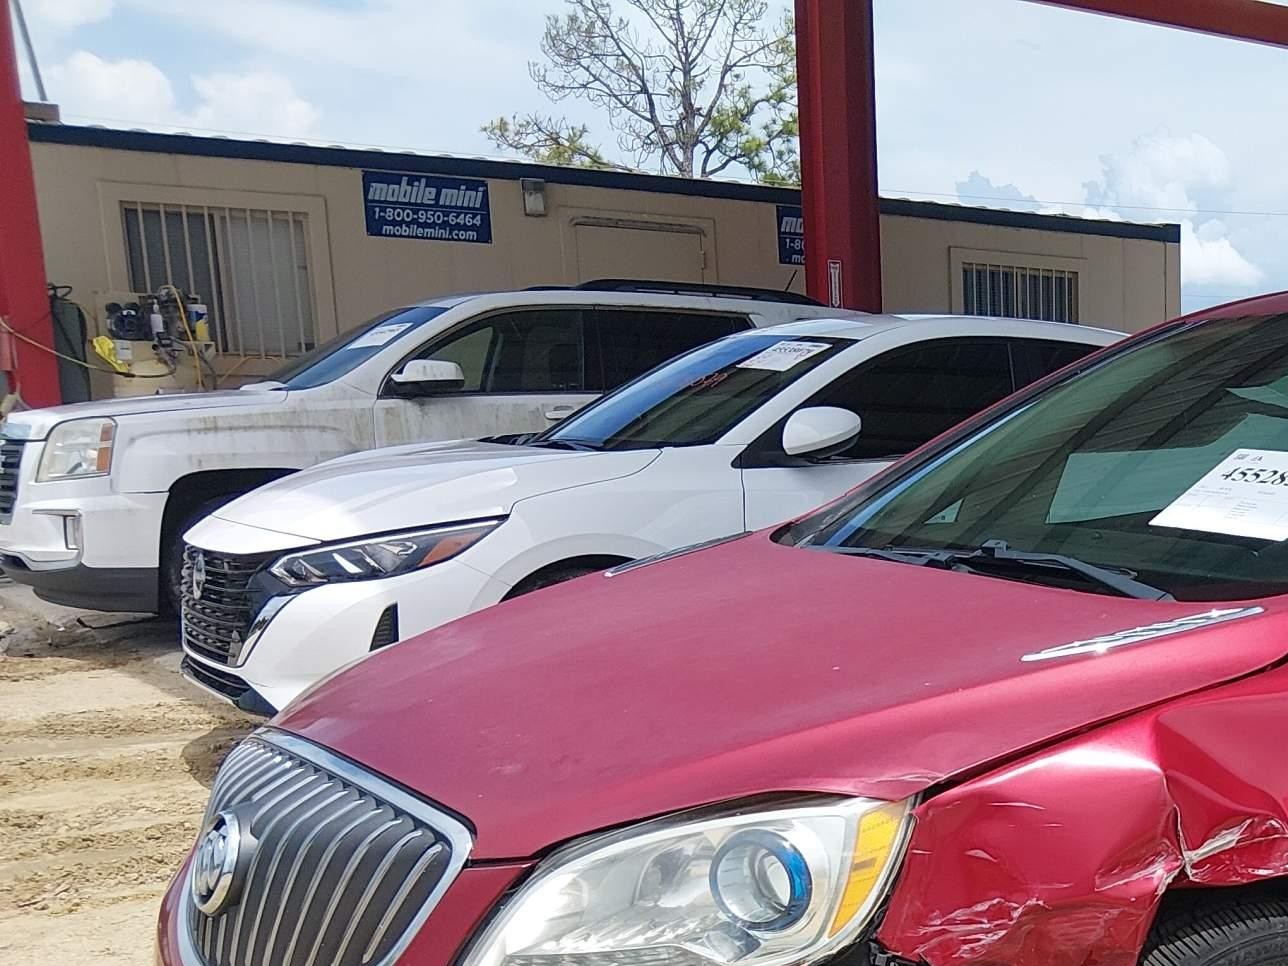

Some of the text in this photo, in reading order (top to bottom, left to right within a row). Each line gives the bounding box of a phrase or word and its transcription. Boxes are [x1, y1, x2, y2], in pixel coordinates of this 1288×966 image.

[367, 176, 484, 208] mobile mini
[374, 207, 482, 226] 1-800-950-6464
[382, 224, 478, 241] mobilemini.com
